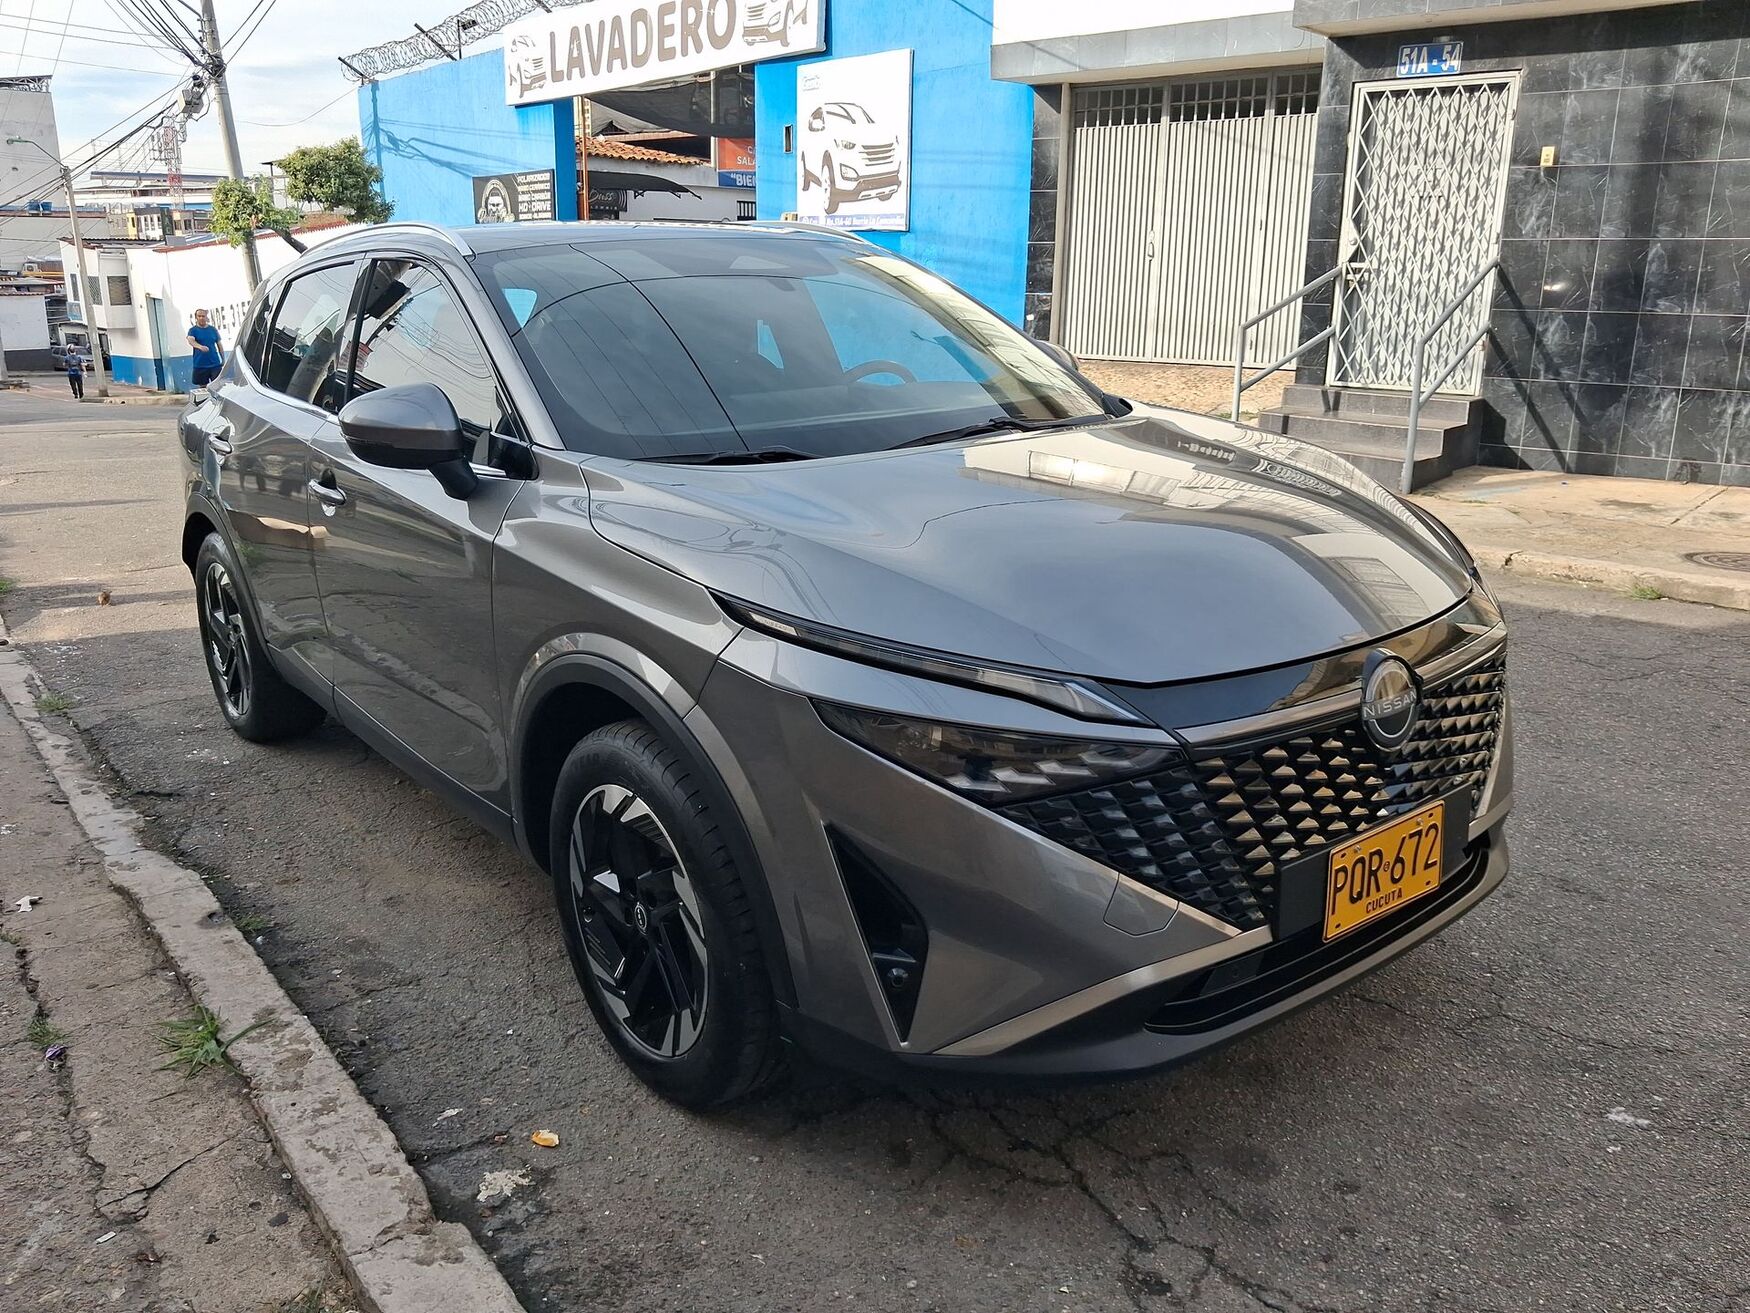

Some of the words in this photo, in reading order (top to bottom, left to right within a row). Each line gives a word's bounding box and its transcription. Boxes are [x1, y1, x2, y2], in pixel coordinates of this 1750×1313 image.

[549, 0, 737, 83] LAVADERO
[1400, 46, 1428, 75] 51A
[1440, 43, 1460, 72] 54
[1362, 689, 1417, 718] NISSAN
[1365, 887, 1403, 914] CUCUTA
